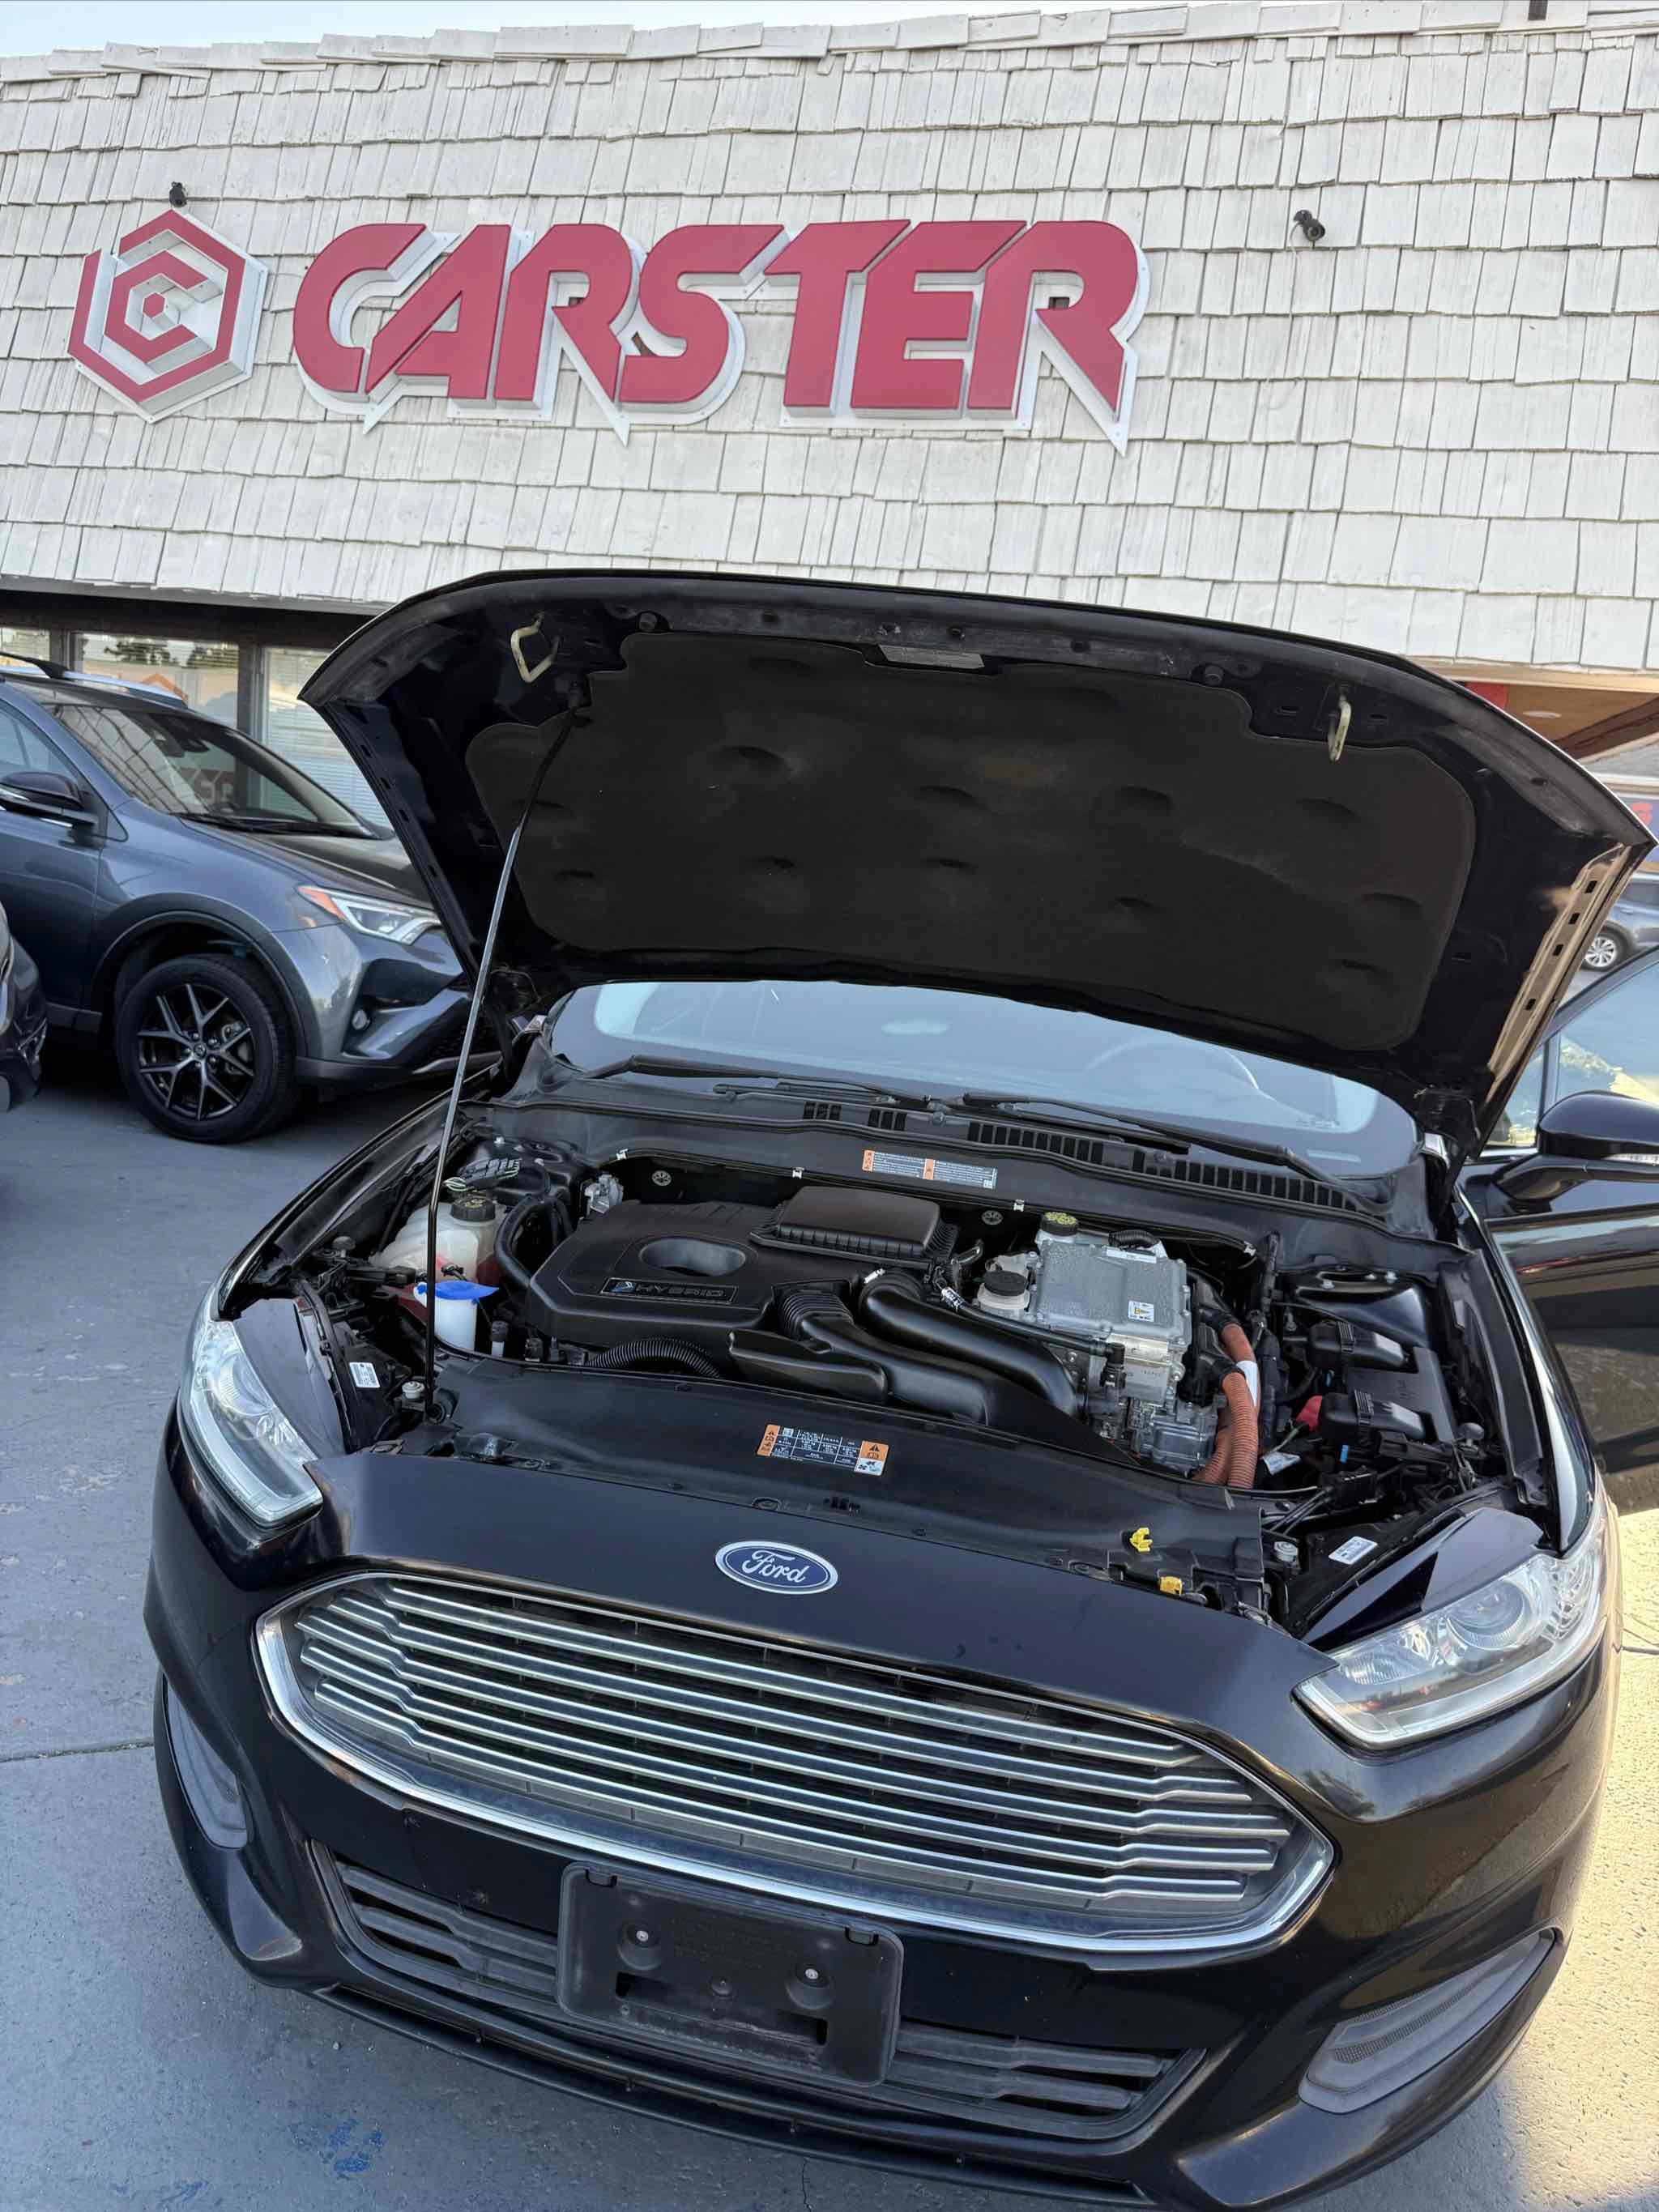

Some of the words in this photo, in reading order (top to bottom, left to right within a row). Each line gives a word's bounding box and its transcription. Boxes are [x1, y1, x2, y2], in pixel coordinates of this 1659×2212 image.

[293, 219, 1138, 410] CARSTER
[636, 1283, 724, 1297] HYBRID
[741, 1549, 809, 1583] Ford
